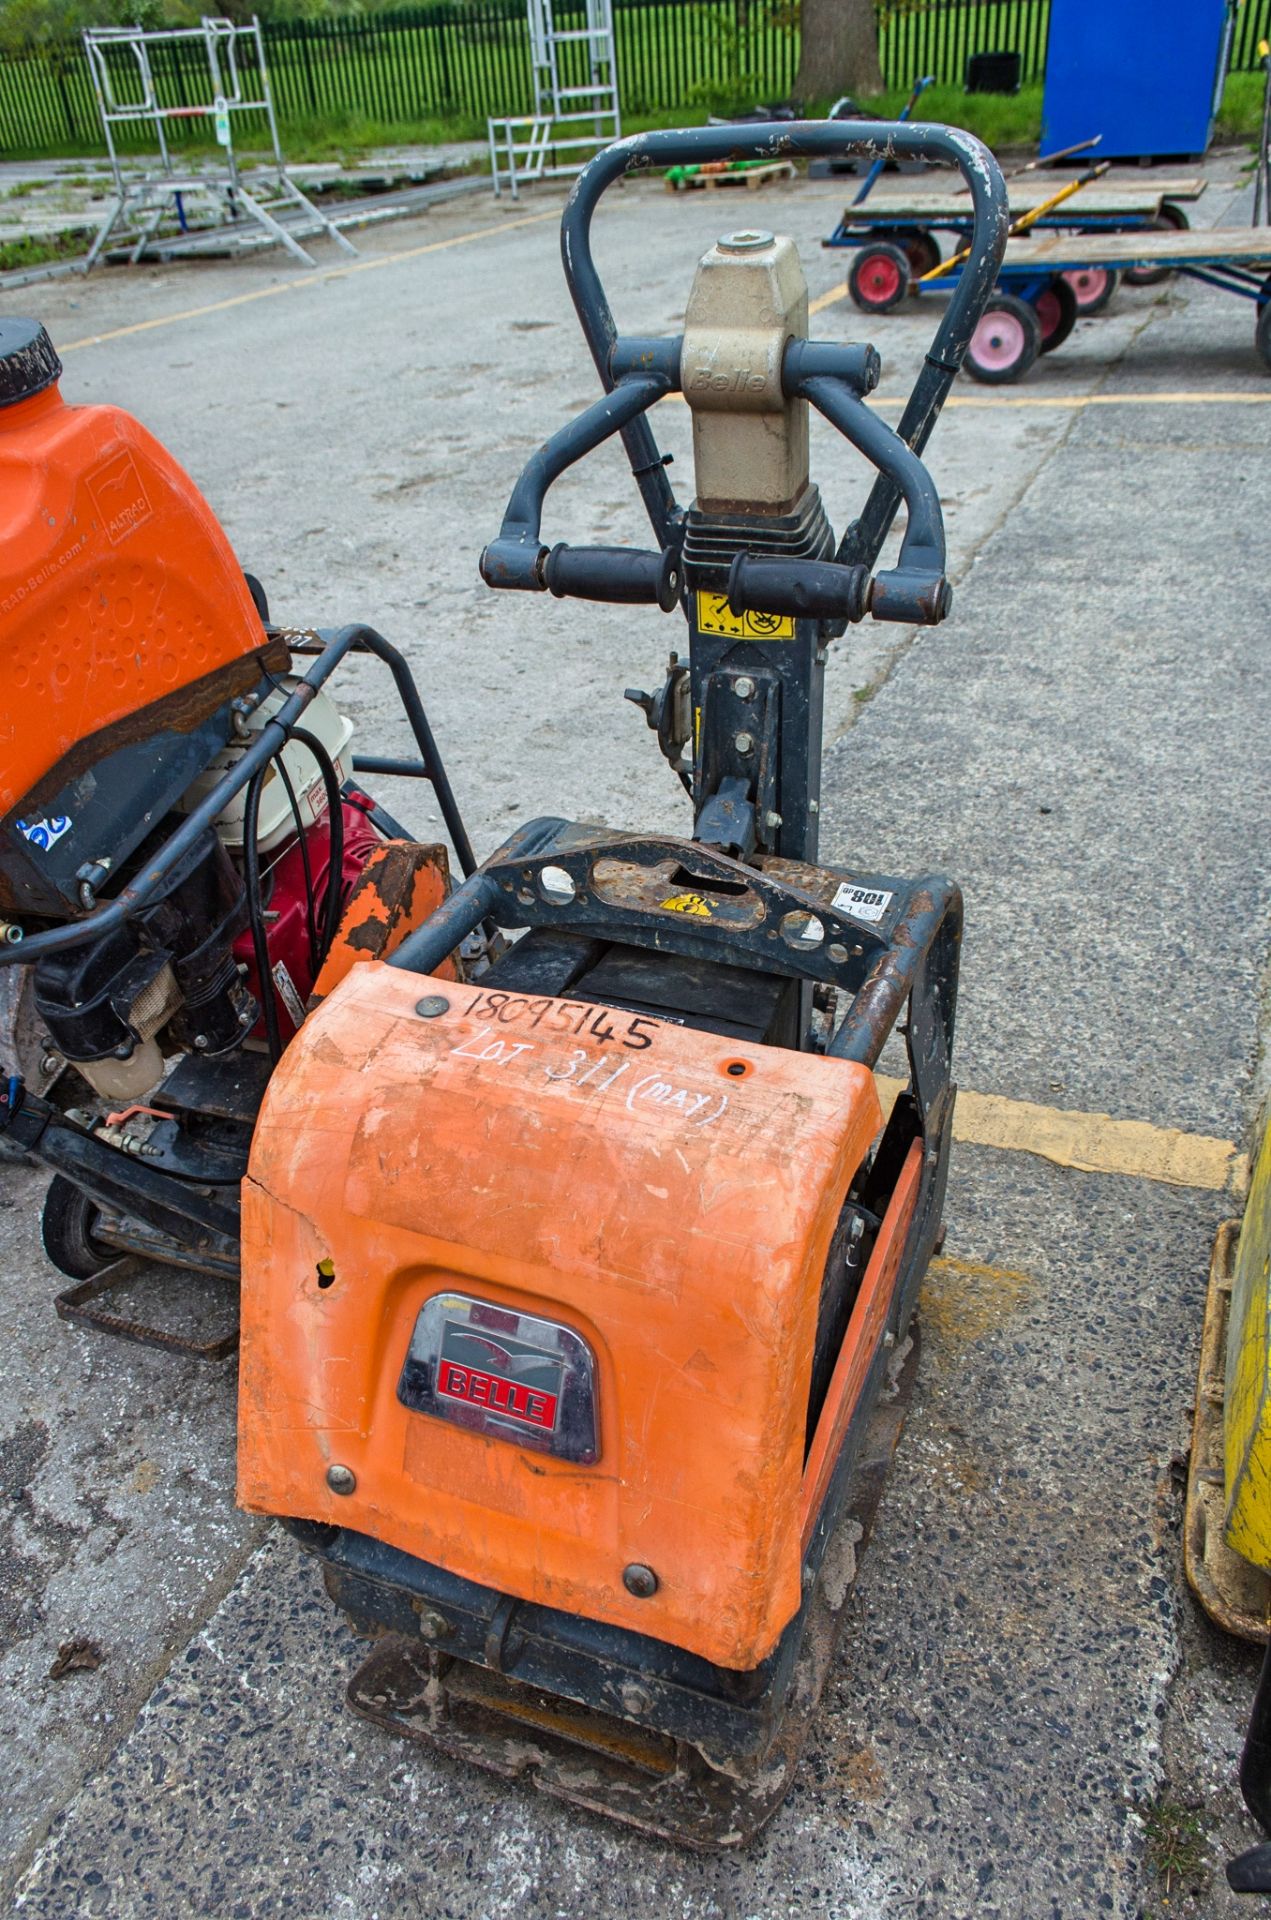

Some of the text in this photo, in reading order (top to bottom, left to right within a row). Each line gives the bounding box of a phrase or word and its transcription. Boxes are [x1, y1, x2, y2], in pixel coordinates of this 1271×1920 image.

[690, 366, 768, 393] Belle
[109, 497, 146, 535] ALTRAD
[0, 543, 82, 615] RAD-Belle.com
[464, 991, 660, 1050] 18095145
[451, 1026, 535, 1065] LOT
[544, 1049, 630, 1091] 311
[446, 1366, 547, 1422] BELLE
